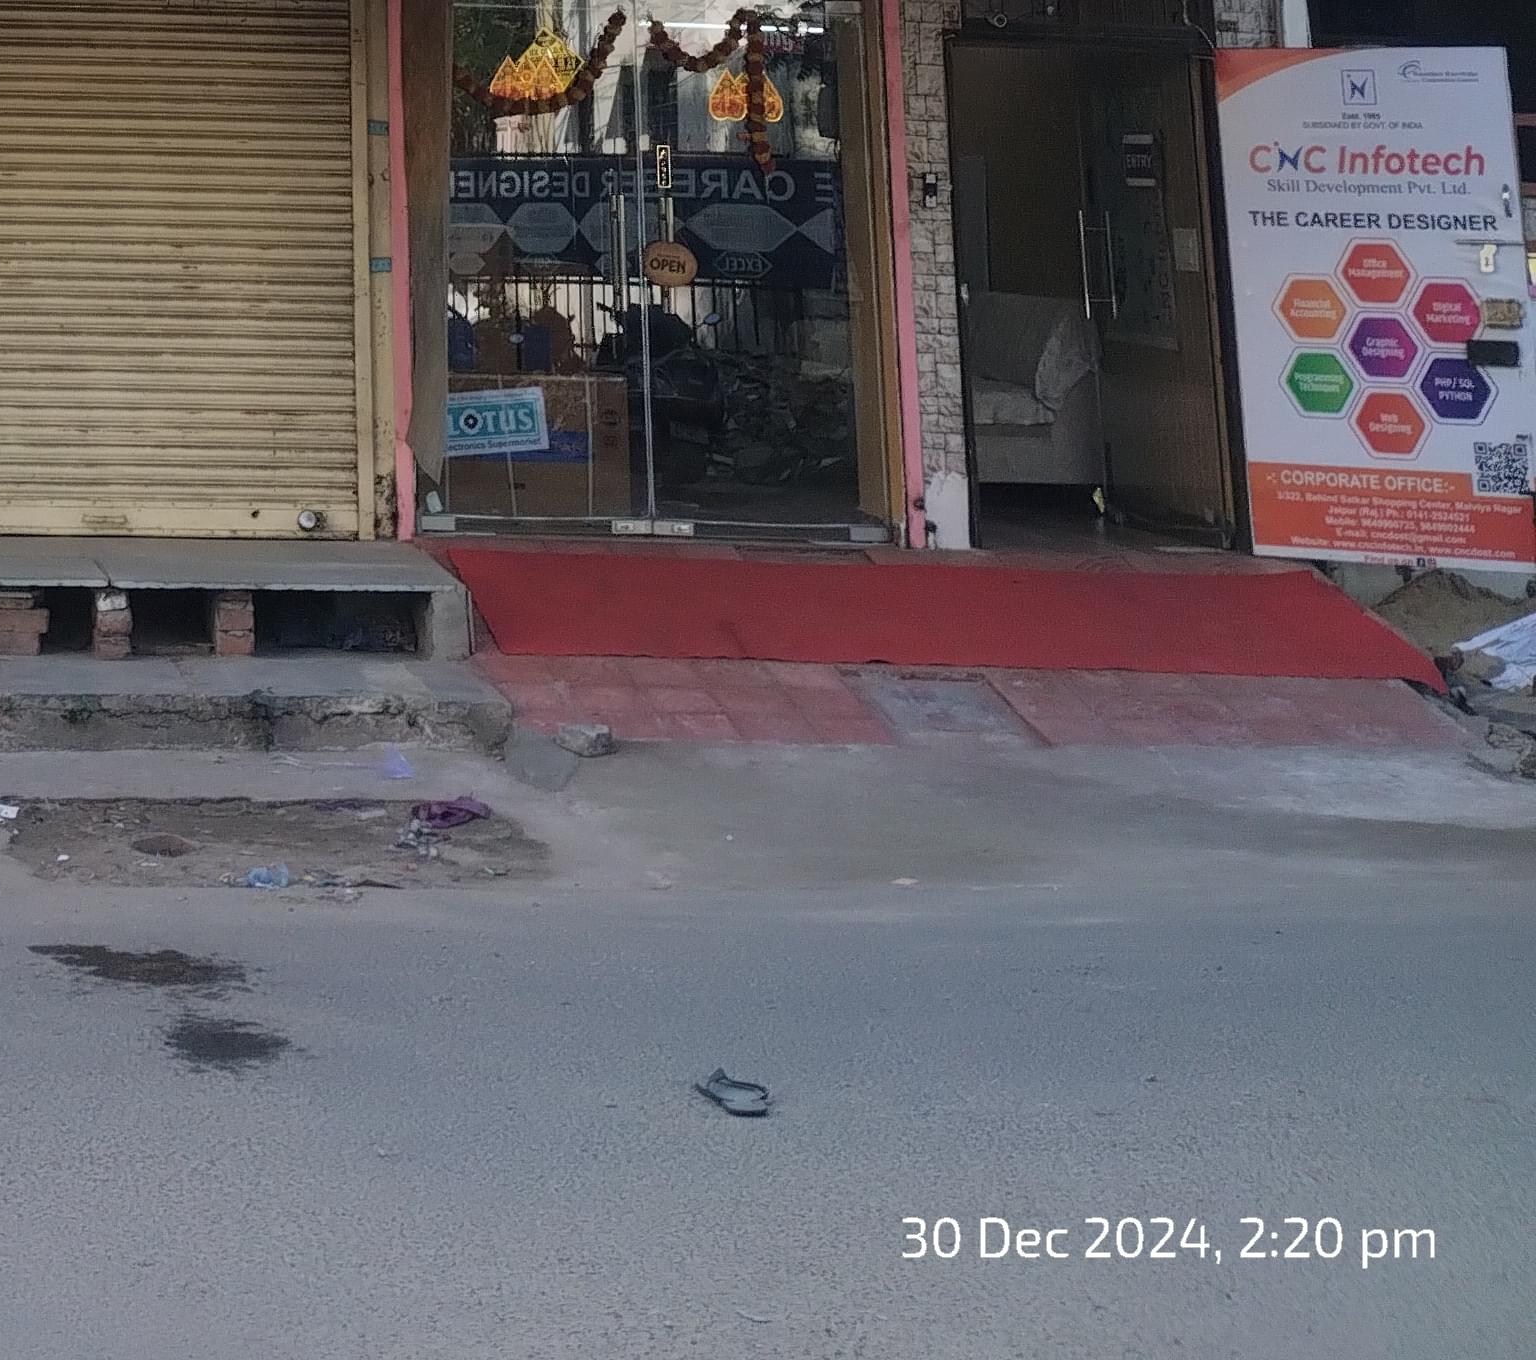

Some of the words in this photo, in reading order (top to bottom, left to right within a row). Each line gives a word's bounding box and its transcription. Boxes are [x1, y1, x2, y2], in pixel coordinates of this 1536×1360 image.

[1125, 153, 1153, 170] ENTRY
[1337, 144, 1486, 177] Infotech
[1267, 179, 1301, 194] Skill
[1305, 179, 1405, 197] Development
[1408, 181, 1437, 195] Pvt.
[1441, 181, 1473, 196] Ltd.
[1248, 210, 1290, 228] THE
[1295, 212, 1383, 230] CAREER
[1388, 213, 1499, 232] DESIGNER
[649, 256, 688, 275] OPEN
[1438, 390, 1473, 402] PYTHON
[447, 440, 487, 453] ectronics
[1280, 469, 1381, 491] CORPORATE
